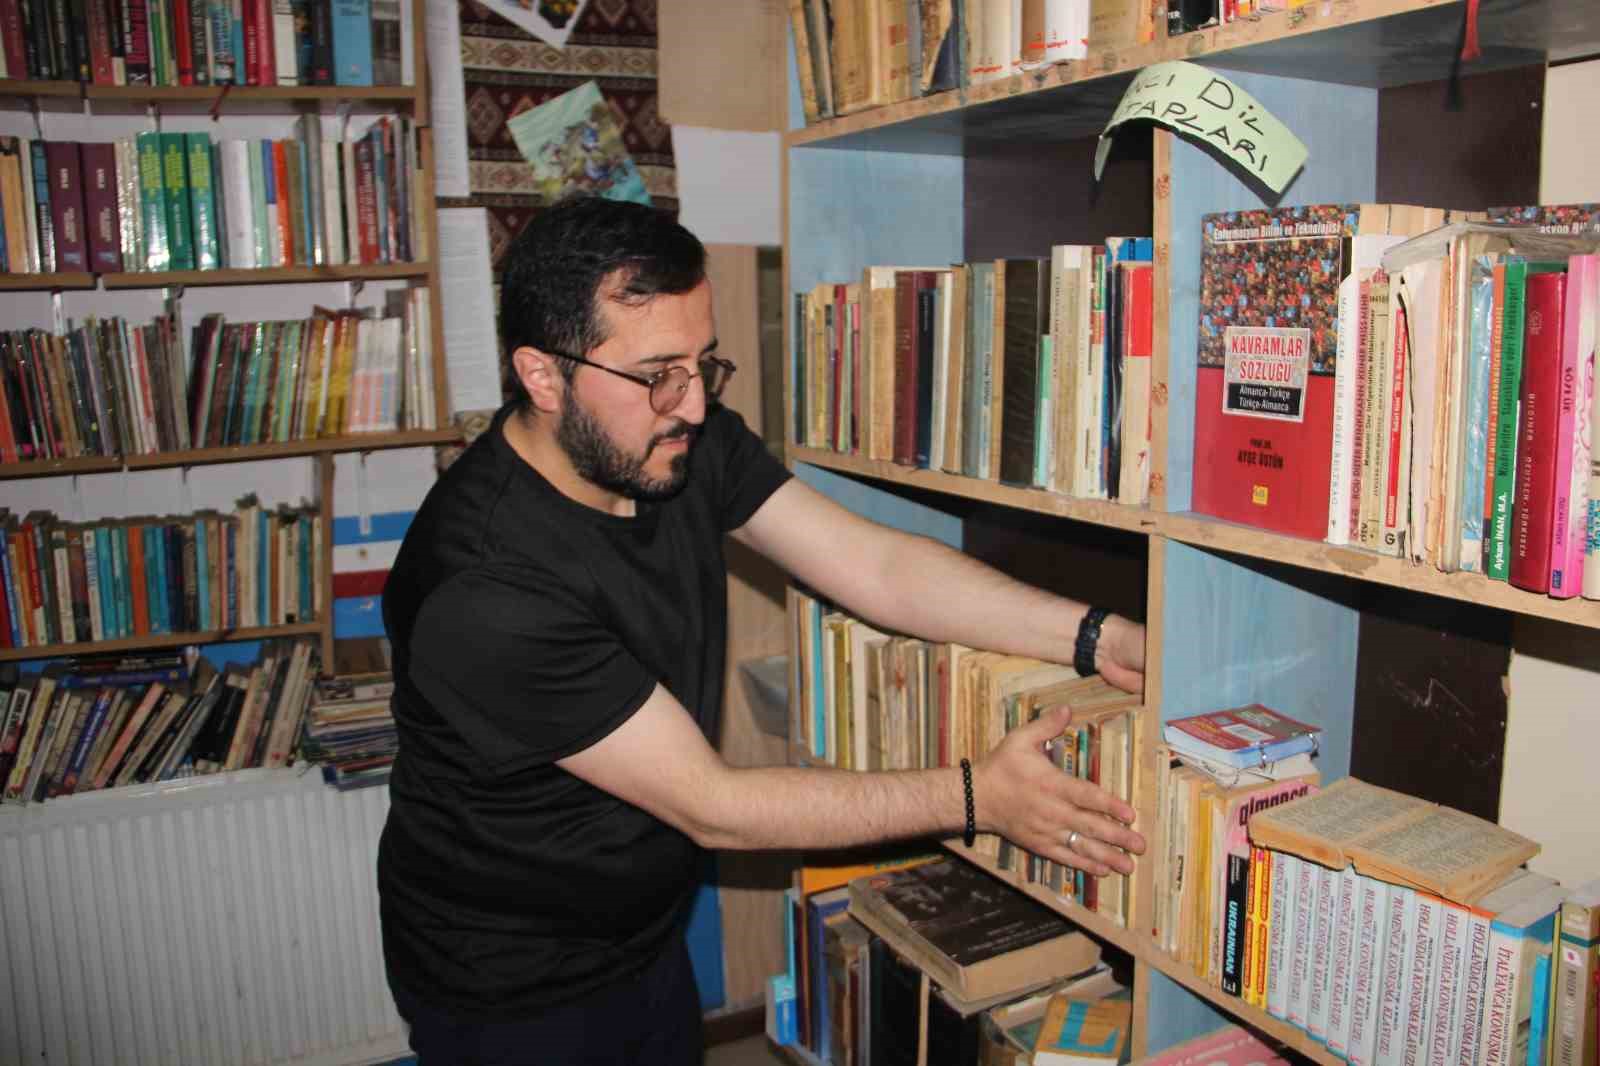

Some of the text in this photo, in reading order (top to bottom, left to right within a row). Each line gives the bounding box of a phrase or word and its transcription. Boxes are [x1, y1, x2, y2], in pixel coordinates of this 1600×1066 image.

[1231, 335, 1303, 357] KAVRAMLAR
[1239, 384, 1291, 401] Almanca-Türkçe
[1239, 396, 1290, 411] Türkçe-Almanca
[1497, 491, 1507, 513] M.A.
[1225, 900, 1239, 975] UKRAINIAN
[1390, 896, 1404, 951] RUMENCE
[1414, 904, 1431, 974] HOLLANDACA
[1441, 913, 1458, 985] HOLLANDACA
[1468, 922, 1486, 996] HOLLANDACA
[1494, 946, 1514, 1009] İTALYANCA
[1408, 974, 1422, 1023] KONUŞMA
[1435, 984, 1450, 1035] KONUŞMA
[1461, 996, 1476, 1047] KONUŞMA
[1405, 1023, 1417, 1066] KLAVUZ
[1487, 1010, 1500, 1063] KONUŞMA
